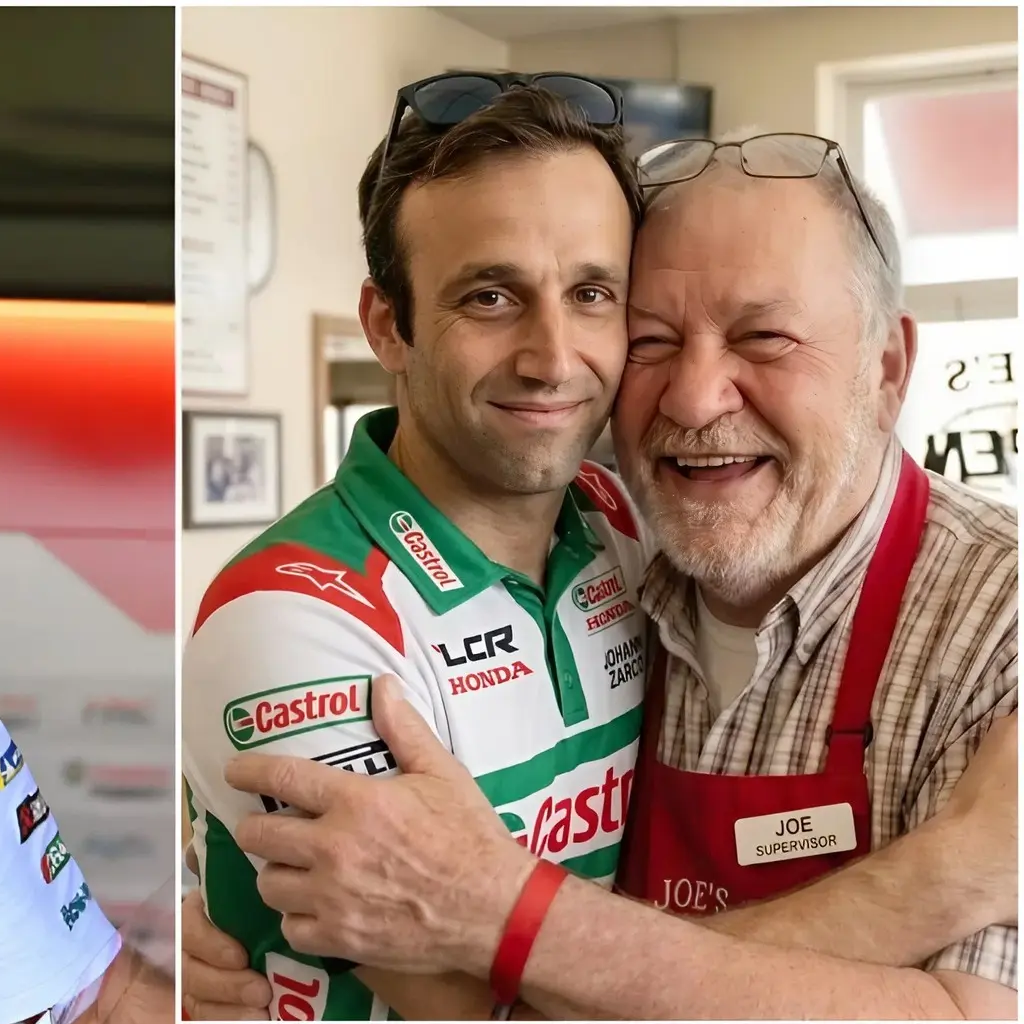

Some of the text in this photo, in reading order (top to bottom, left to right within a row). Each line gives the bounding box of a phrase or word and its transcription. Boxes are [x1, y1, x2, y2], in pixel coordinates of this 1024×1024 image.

[403, 530, 457, 588] Castrol
[438, 624, 519, 667] LCR
[448, 660, 534, 695] HONDA
[255, 684, 360, 733] Castrol
[775, 816, 814, 837] JOE
[755, 834, 838, 857] SUPERVISOR
[655, 878, 729, 913] JOE'S
